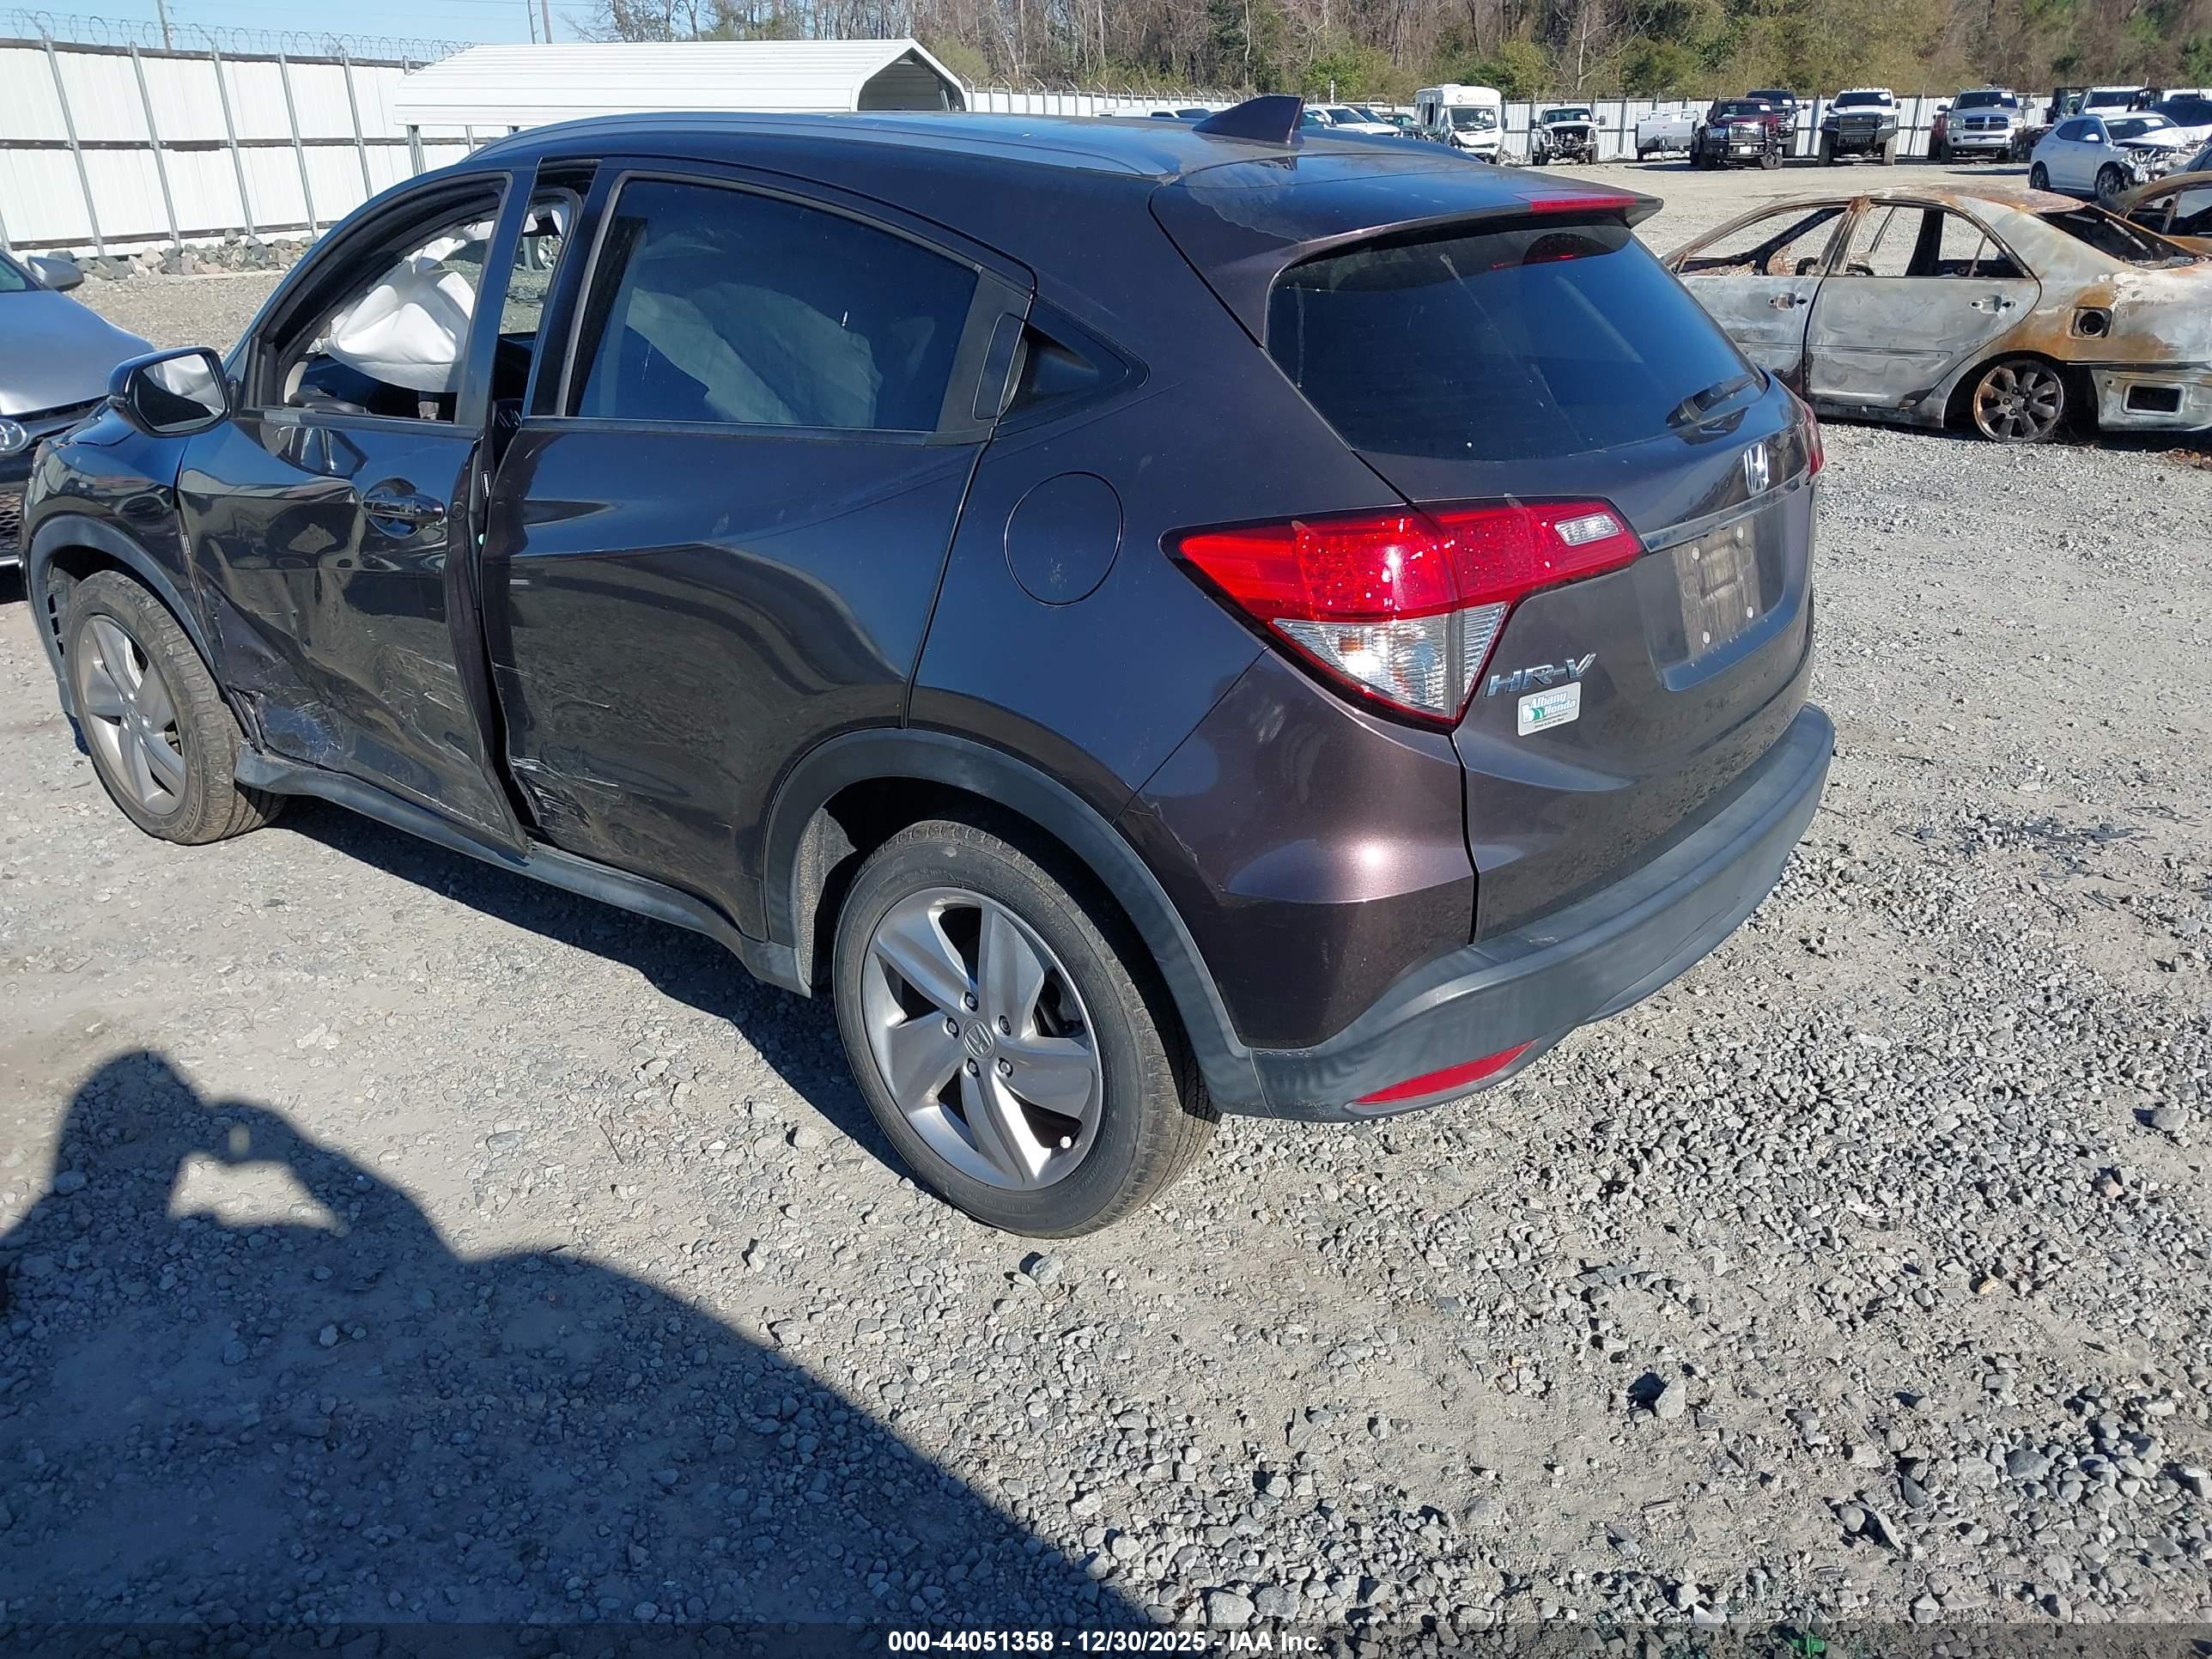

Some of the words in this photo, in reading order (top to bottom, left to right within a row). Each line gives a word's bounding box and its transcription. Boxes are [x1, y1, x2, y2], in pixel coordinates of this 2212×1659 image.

[1485, 652, 1597, 698] HR-V
[1531, 691, 1567, 708] Albany
[1544, 698, 1577, 716] Honda
